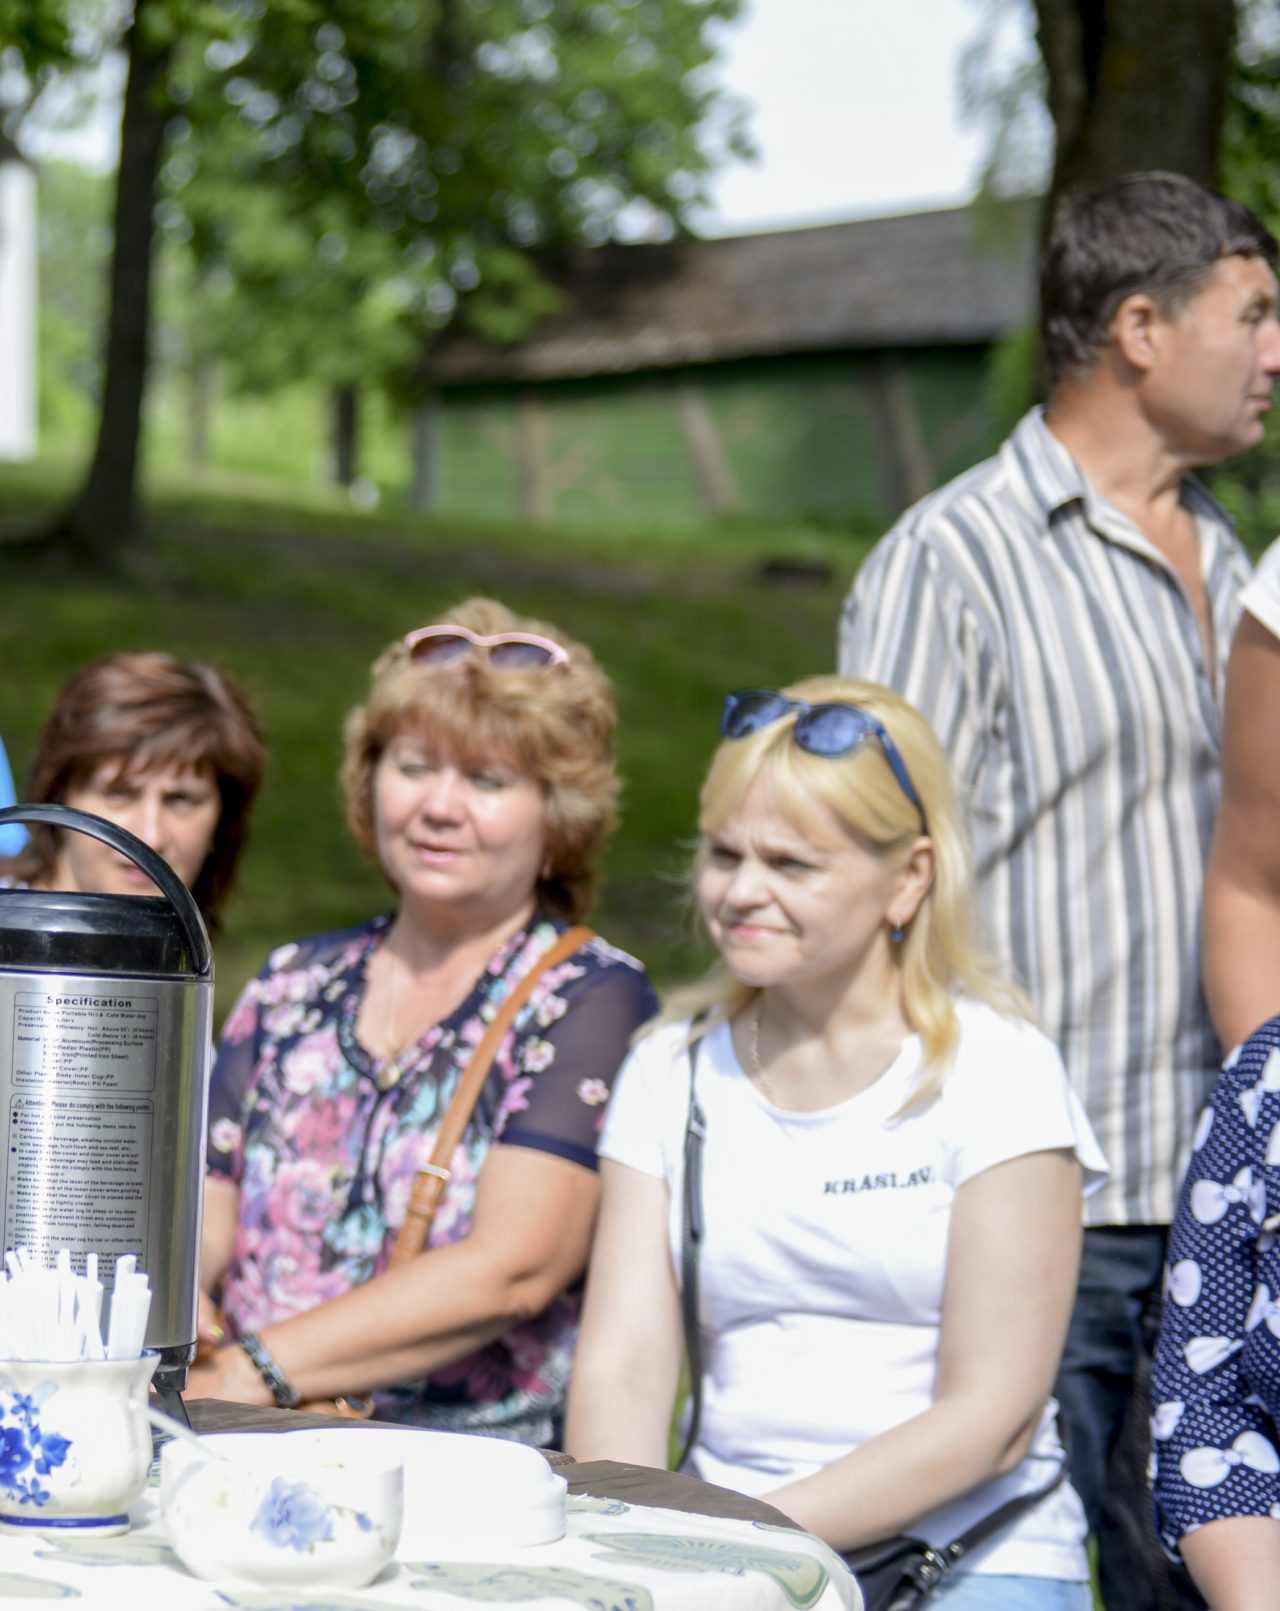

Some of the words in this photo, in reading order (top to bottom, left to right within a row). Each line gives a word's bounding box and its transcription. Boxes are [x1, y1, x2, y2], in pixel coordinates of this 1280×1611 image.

[47, 996, 132, 1007] Specification
[76, 1103, 94, 1112] comply
[115, 1104, 136, 1112] following
[823, 1165, 935, 1194] KRASLAV
